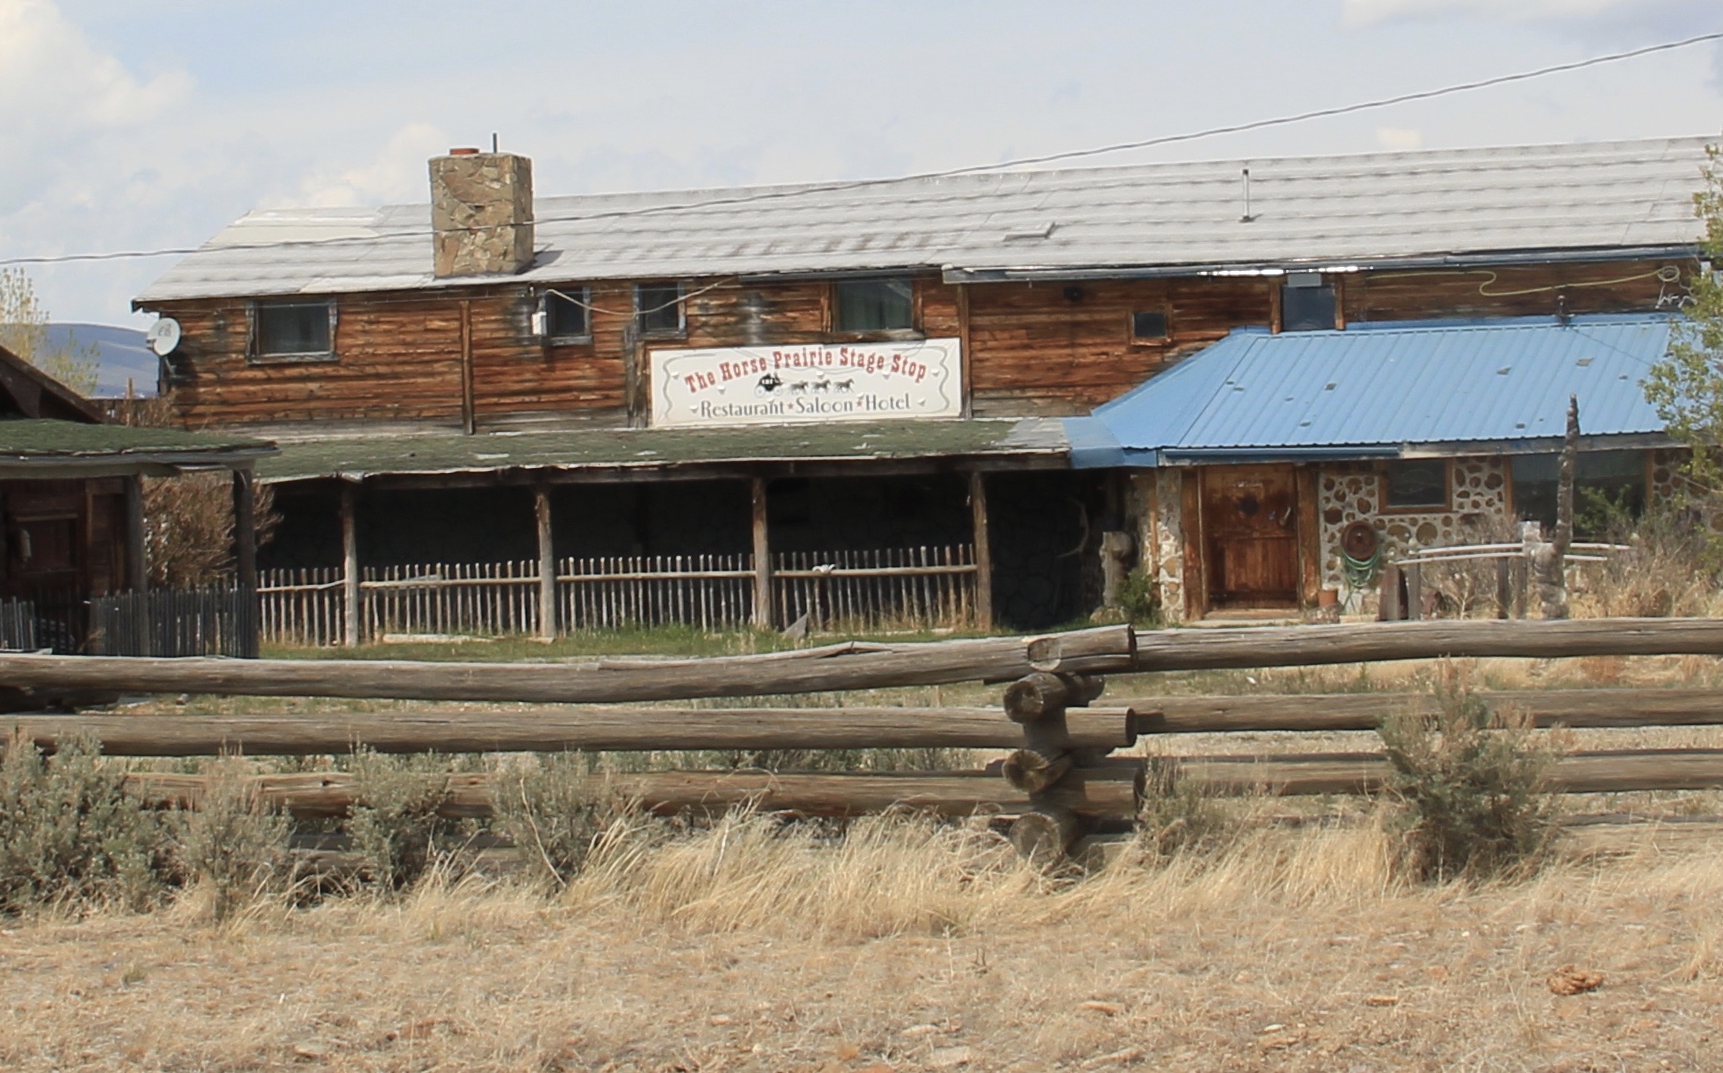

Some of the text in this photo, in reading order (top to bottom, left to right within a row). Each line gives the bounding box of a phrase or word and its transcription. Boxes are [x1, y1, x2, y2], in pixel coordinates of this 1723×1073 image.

[684, 346, 926, 393] The Horse Prairie Stage Stop
[700, 392, 910, 419] Restaurant Saloon Hotel
